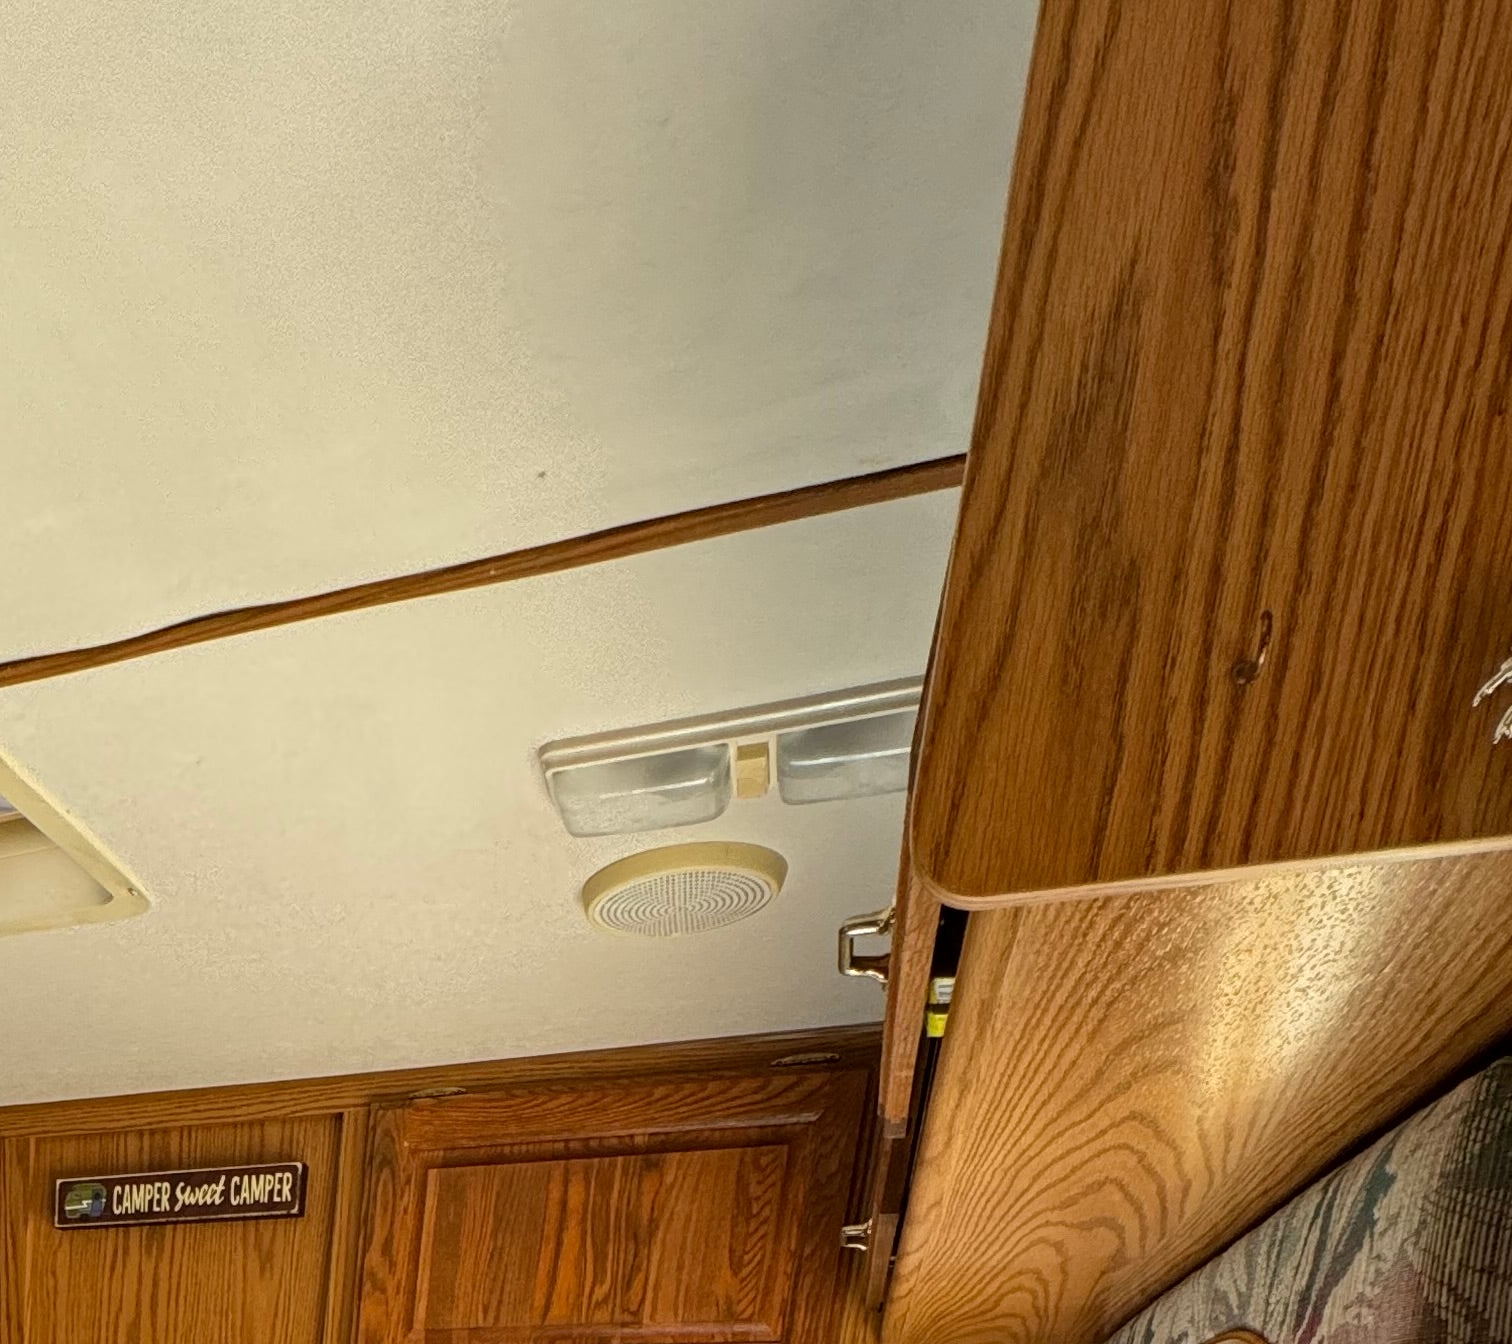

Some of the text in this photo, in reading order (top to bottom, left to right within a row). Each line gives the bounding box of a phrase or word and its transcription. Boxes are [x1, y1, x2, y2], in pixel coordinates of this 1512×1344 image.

[112, 1172, 293, 1215] CAMPER Sweet CAMPER
